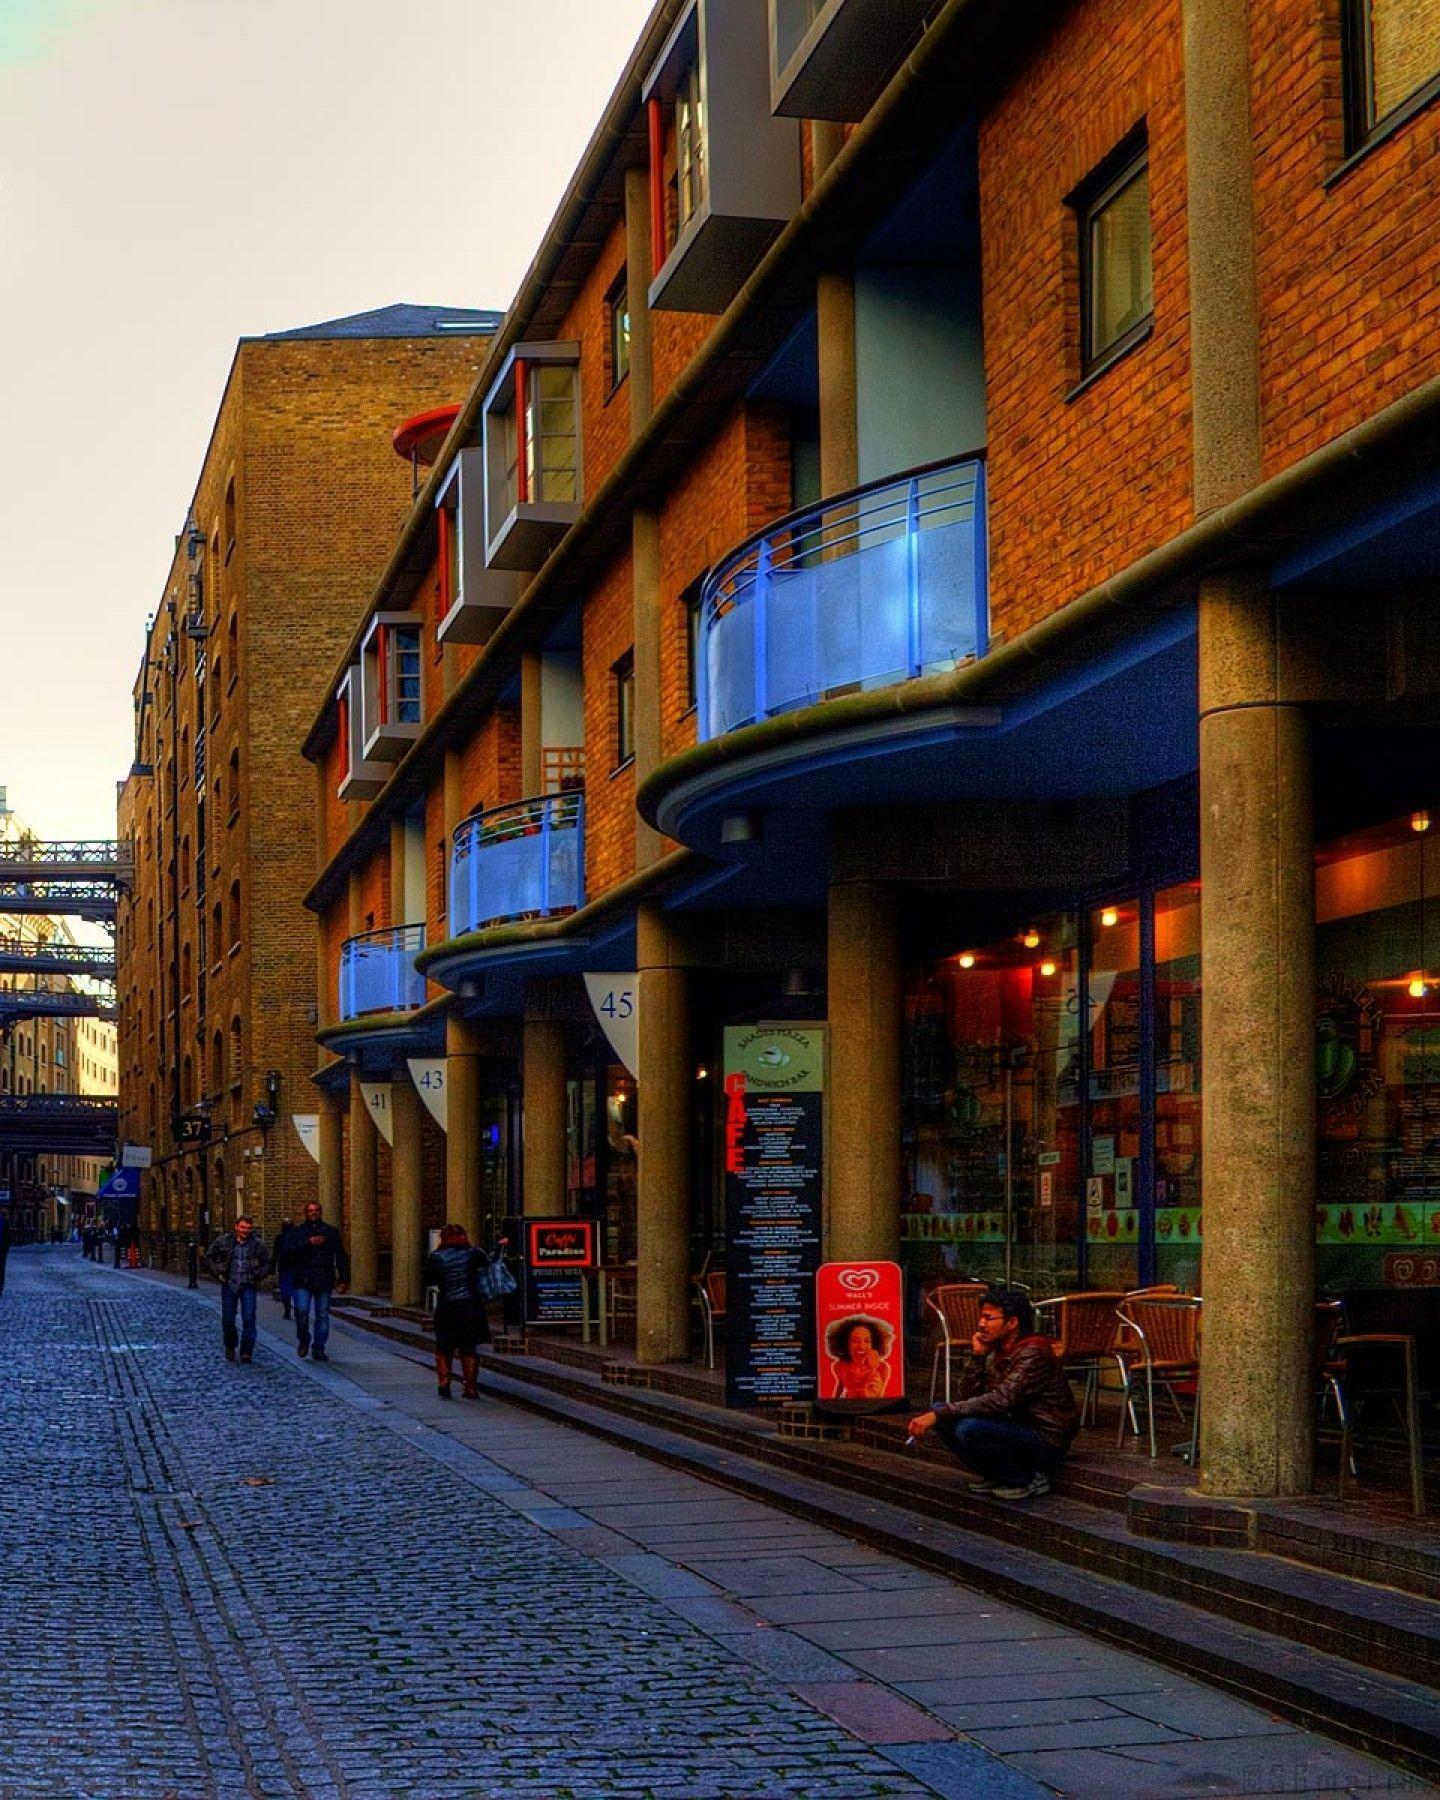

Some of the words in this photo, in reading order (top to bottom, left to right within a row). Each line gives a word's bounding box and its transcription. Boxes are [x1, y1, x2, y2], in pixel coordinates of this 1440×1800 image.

[600, 991, 633, 1018] 45
[420, 1070, 444, 1089] 43
[371, 1093, 385, 1109] 41
[182, 1121, 202, 1137] 37
[724, 1073, 747, 1173] CAFE
